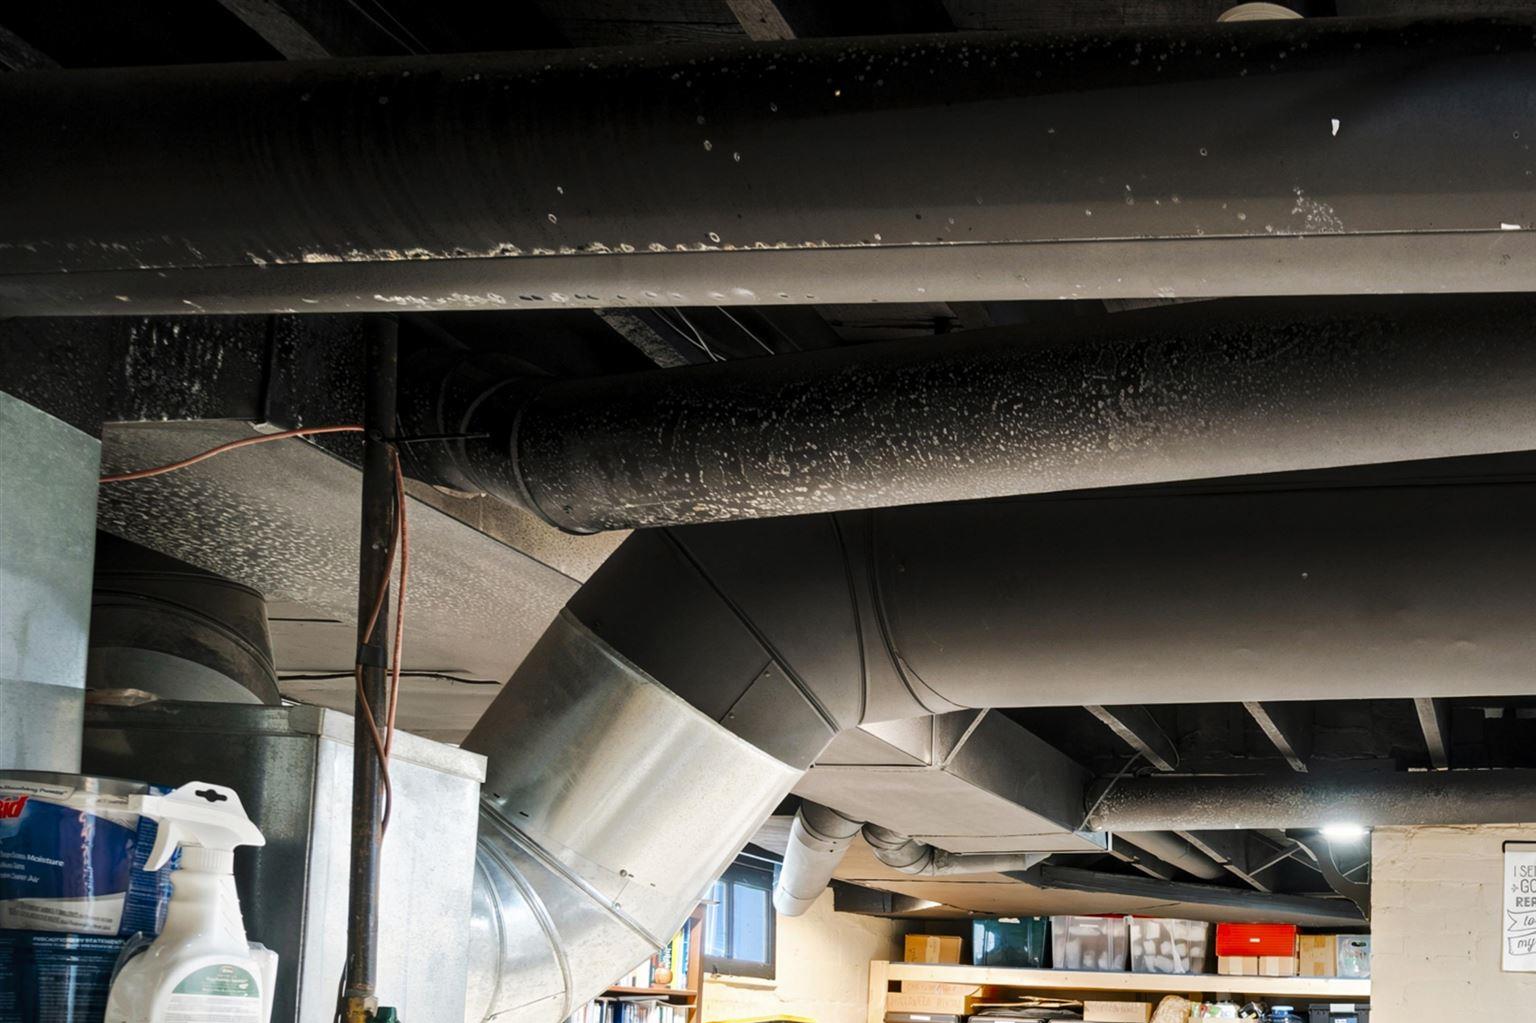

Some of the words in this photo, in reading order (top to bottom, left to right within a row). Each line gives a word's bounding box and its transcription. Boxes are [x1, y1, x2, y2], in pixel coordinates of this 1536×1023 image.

[1513, 865, 1517, 878] I
[1523, 914, 1535, 926] to
[1517, 936, 1536, 952] my
